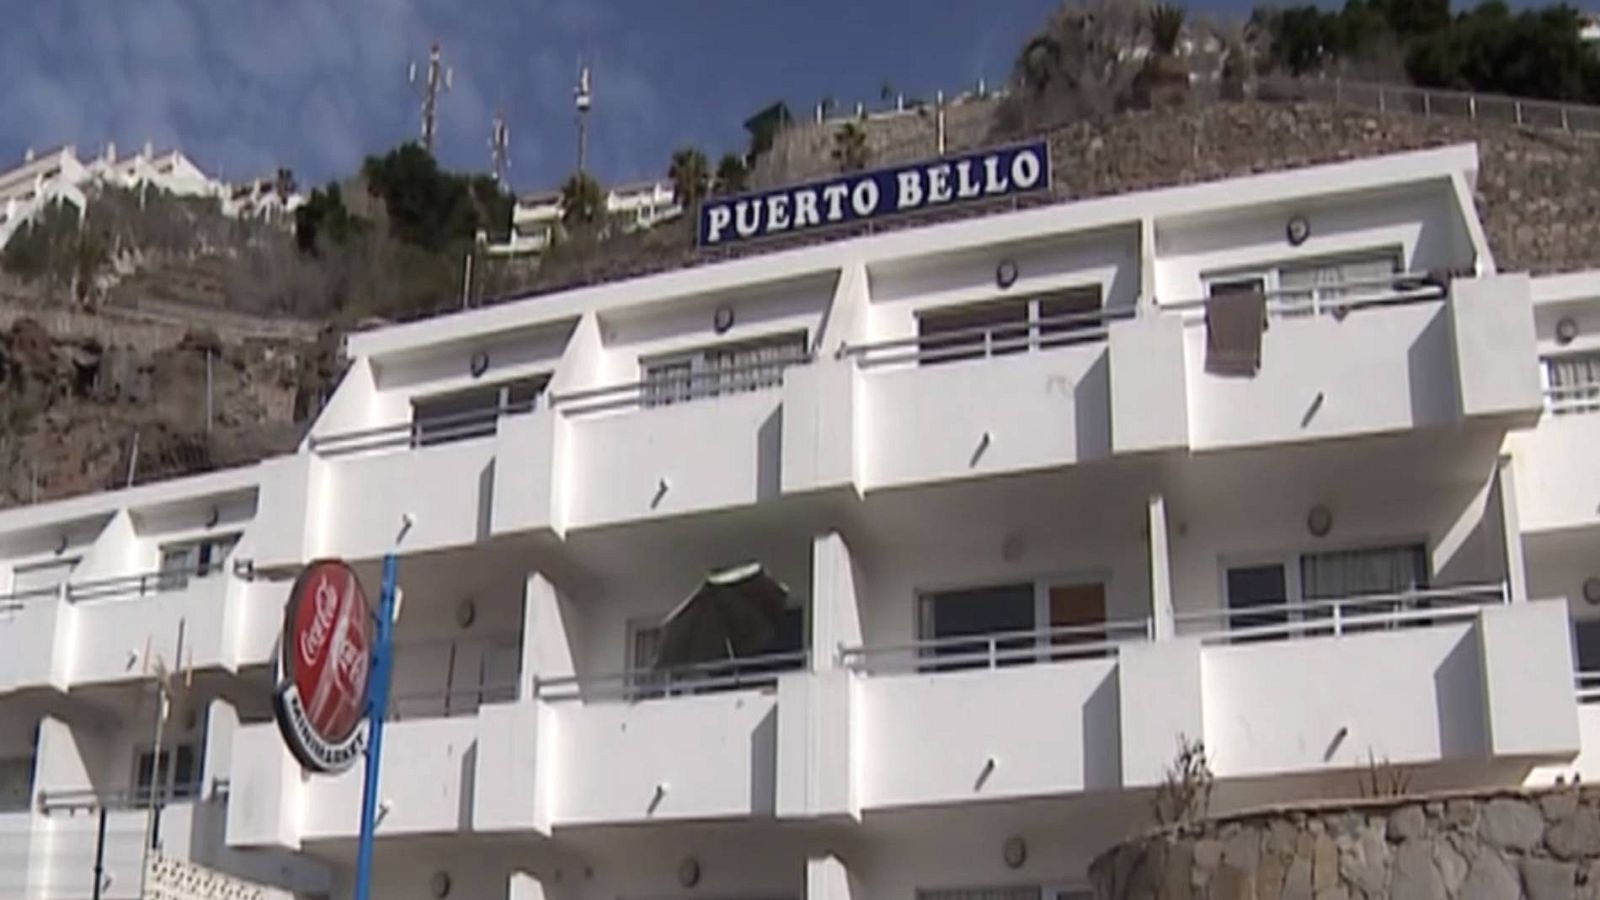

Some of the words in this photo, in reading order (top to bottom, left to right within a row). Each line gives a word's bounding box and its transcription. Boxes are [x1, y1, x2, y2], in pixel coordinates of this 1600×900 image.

[708, 179, 879, 242] PUERTO
[897, 150, 1040, 209] BELLO
[291, 696, 364, 763] MINIMARKET
